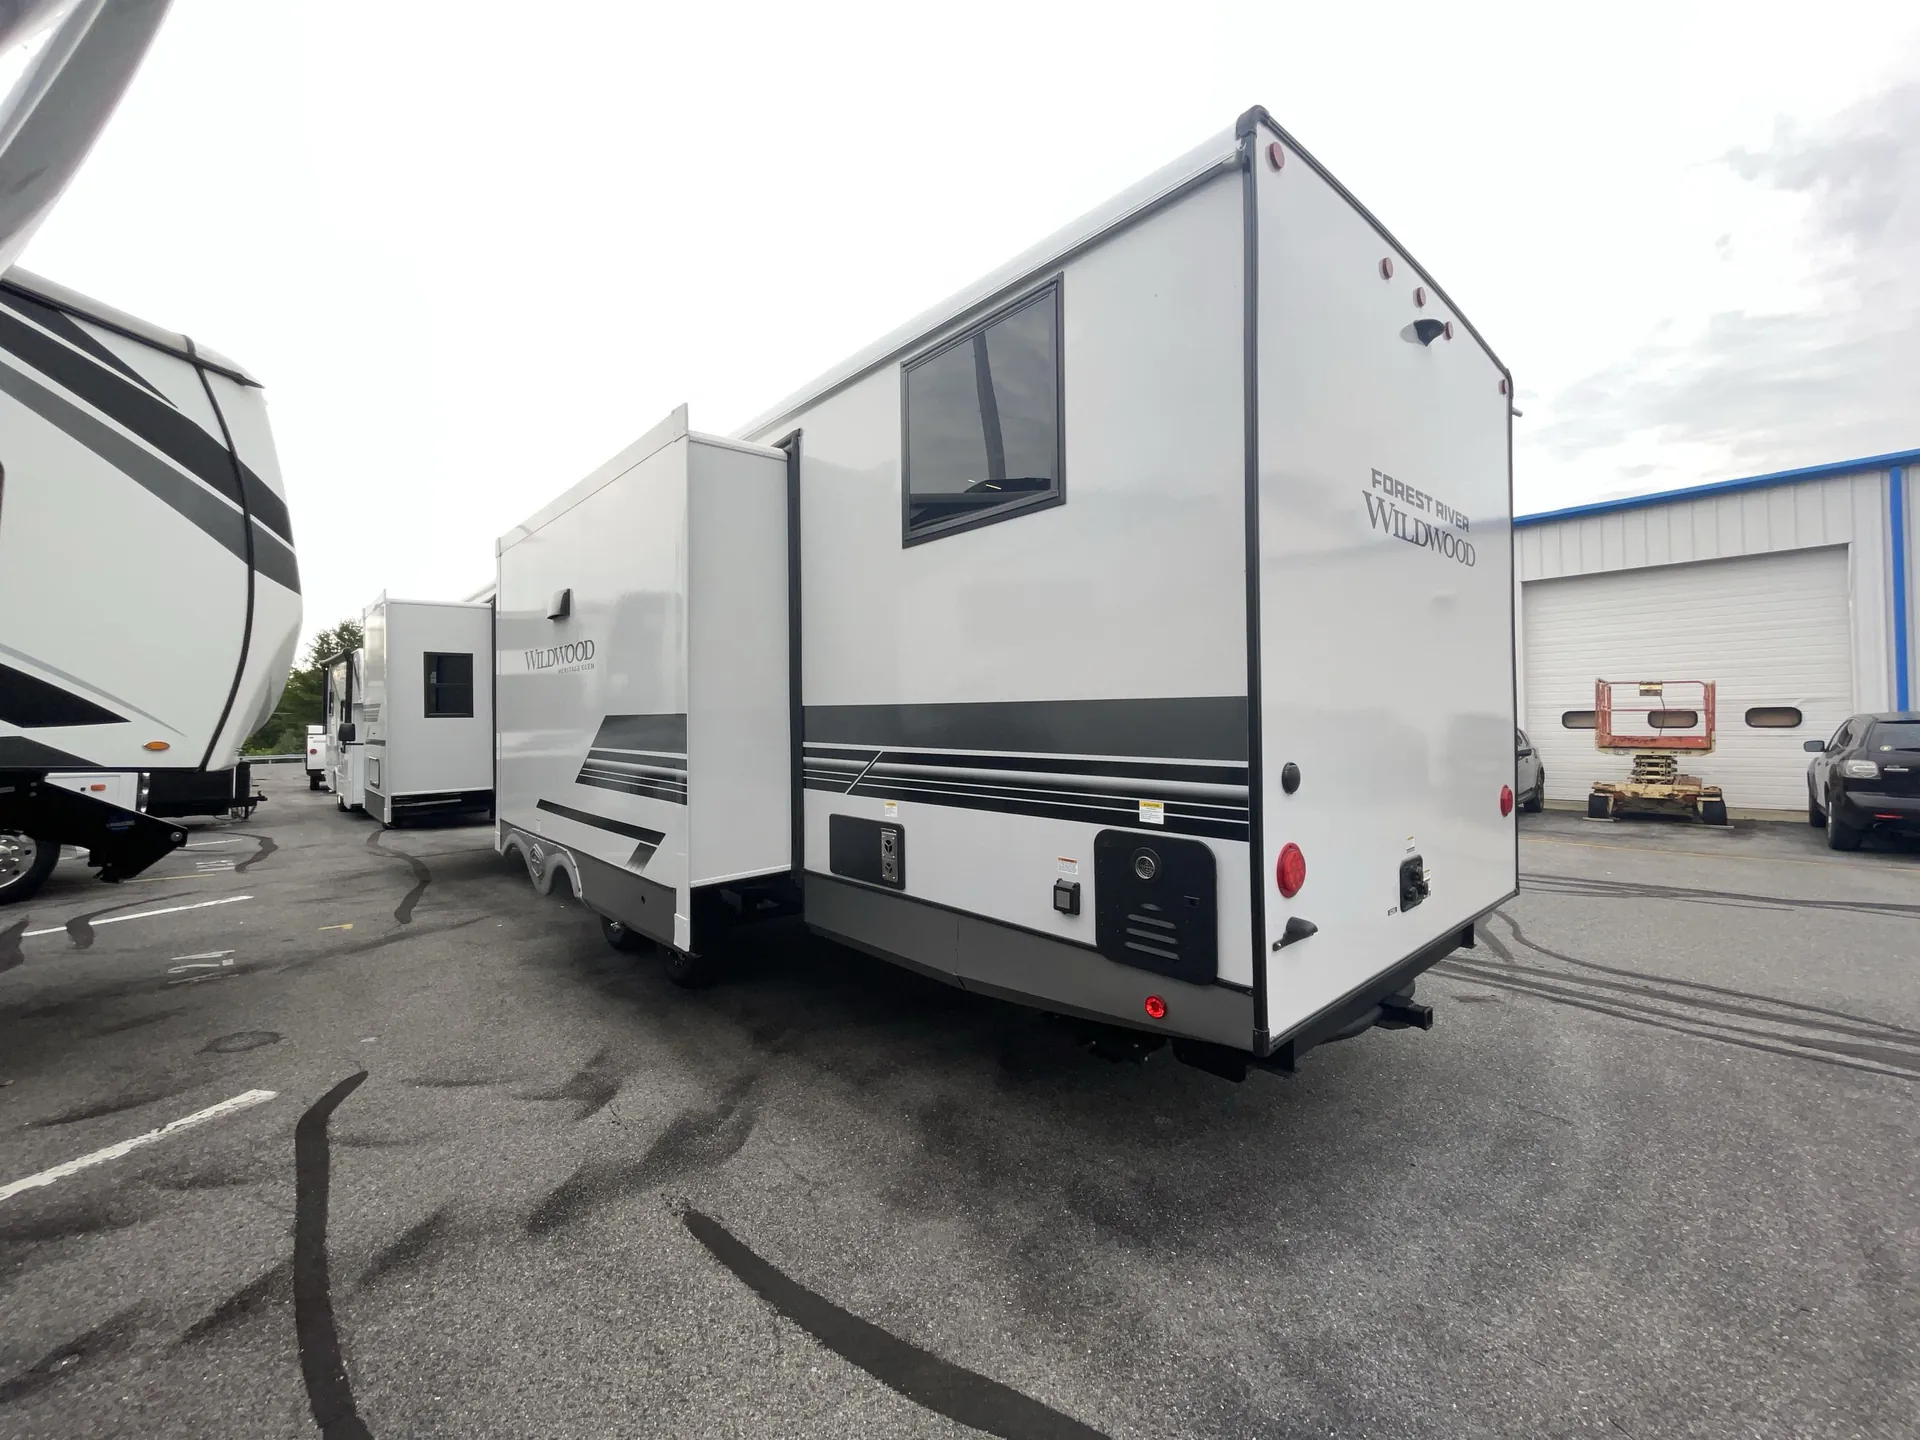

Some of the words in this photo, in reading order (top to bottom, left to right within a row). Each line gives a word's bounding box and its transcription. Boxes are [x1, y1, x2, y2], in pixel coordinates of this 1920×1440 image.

[1362, 490, 1476, 567] WILDWOOD
[1371, 468, 1433, 513] FOREST
[1435, 499, 1470, 533] RIVER
[525, 639, 595, 671] WILDWOOD
